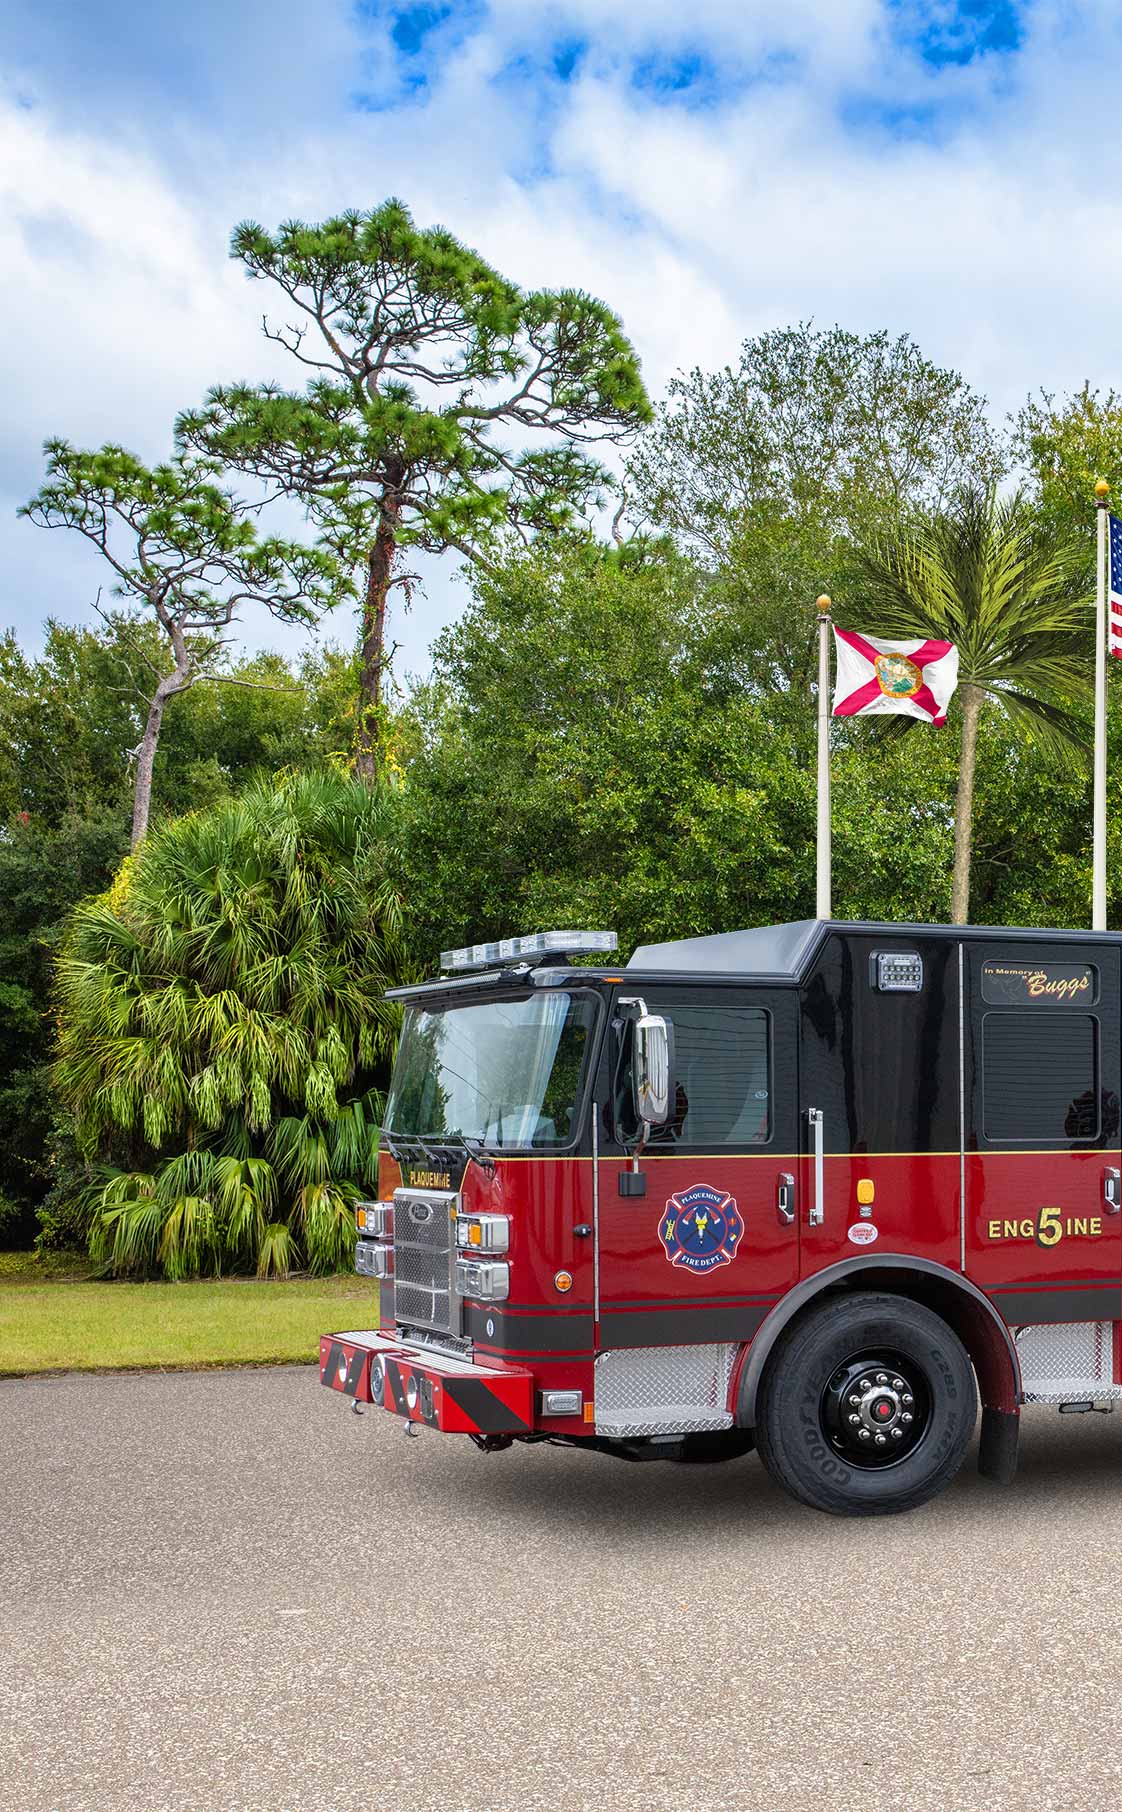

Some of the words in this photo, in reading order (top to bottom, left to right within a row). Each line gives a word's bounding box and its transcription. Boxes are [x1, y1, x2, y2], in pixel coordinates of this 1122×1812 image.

[996, 968, 1032, 976] Memory
[682, 1193, 721, 1204] PLAQUEMINE
[681, 1255, 700, 1266] FIRE
[700, 1254, 723, 1266] DEPT.
